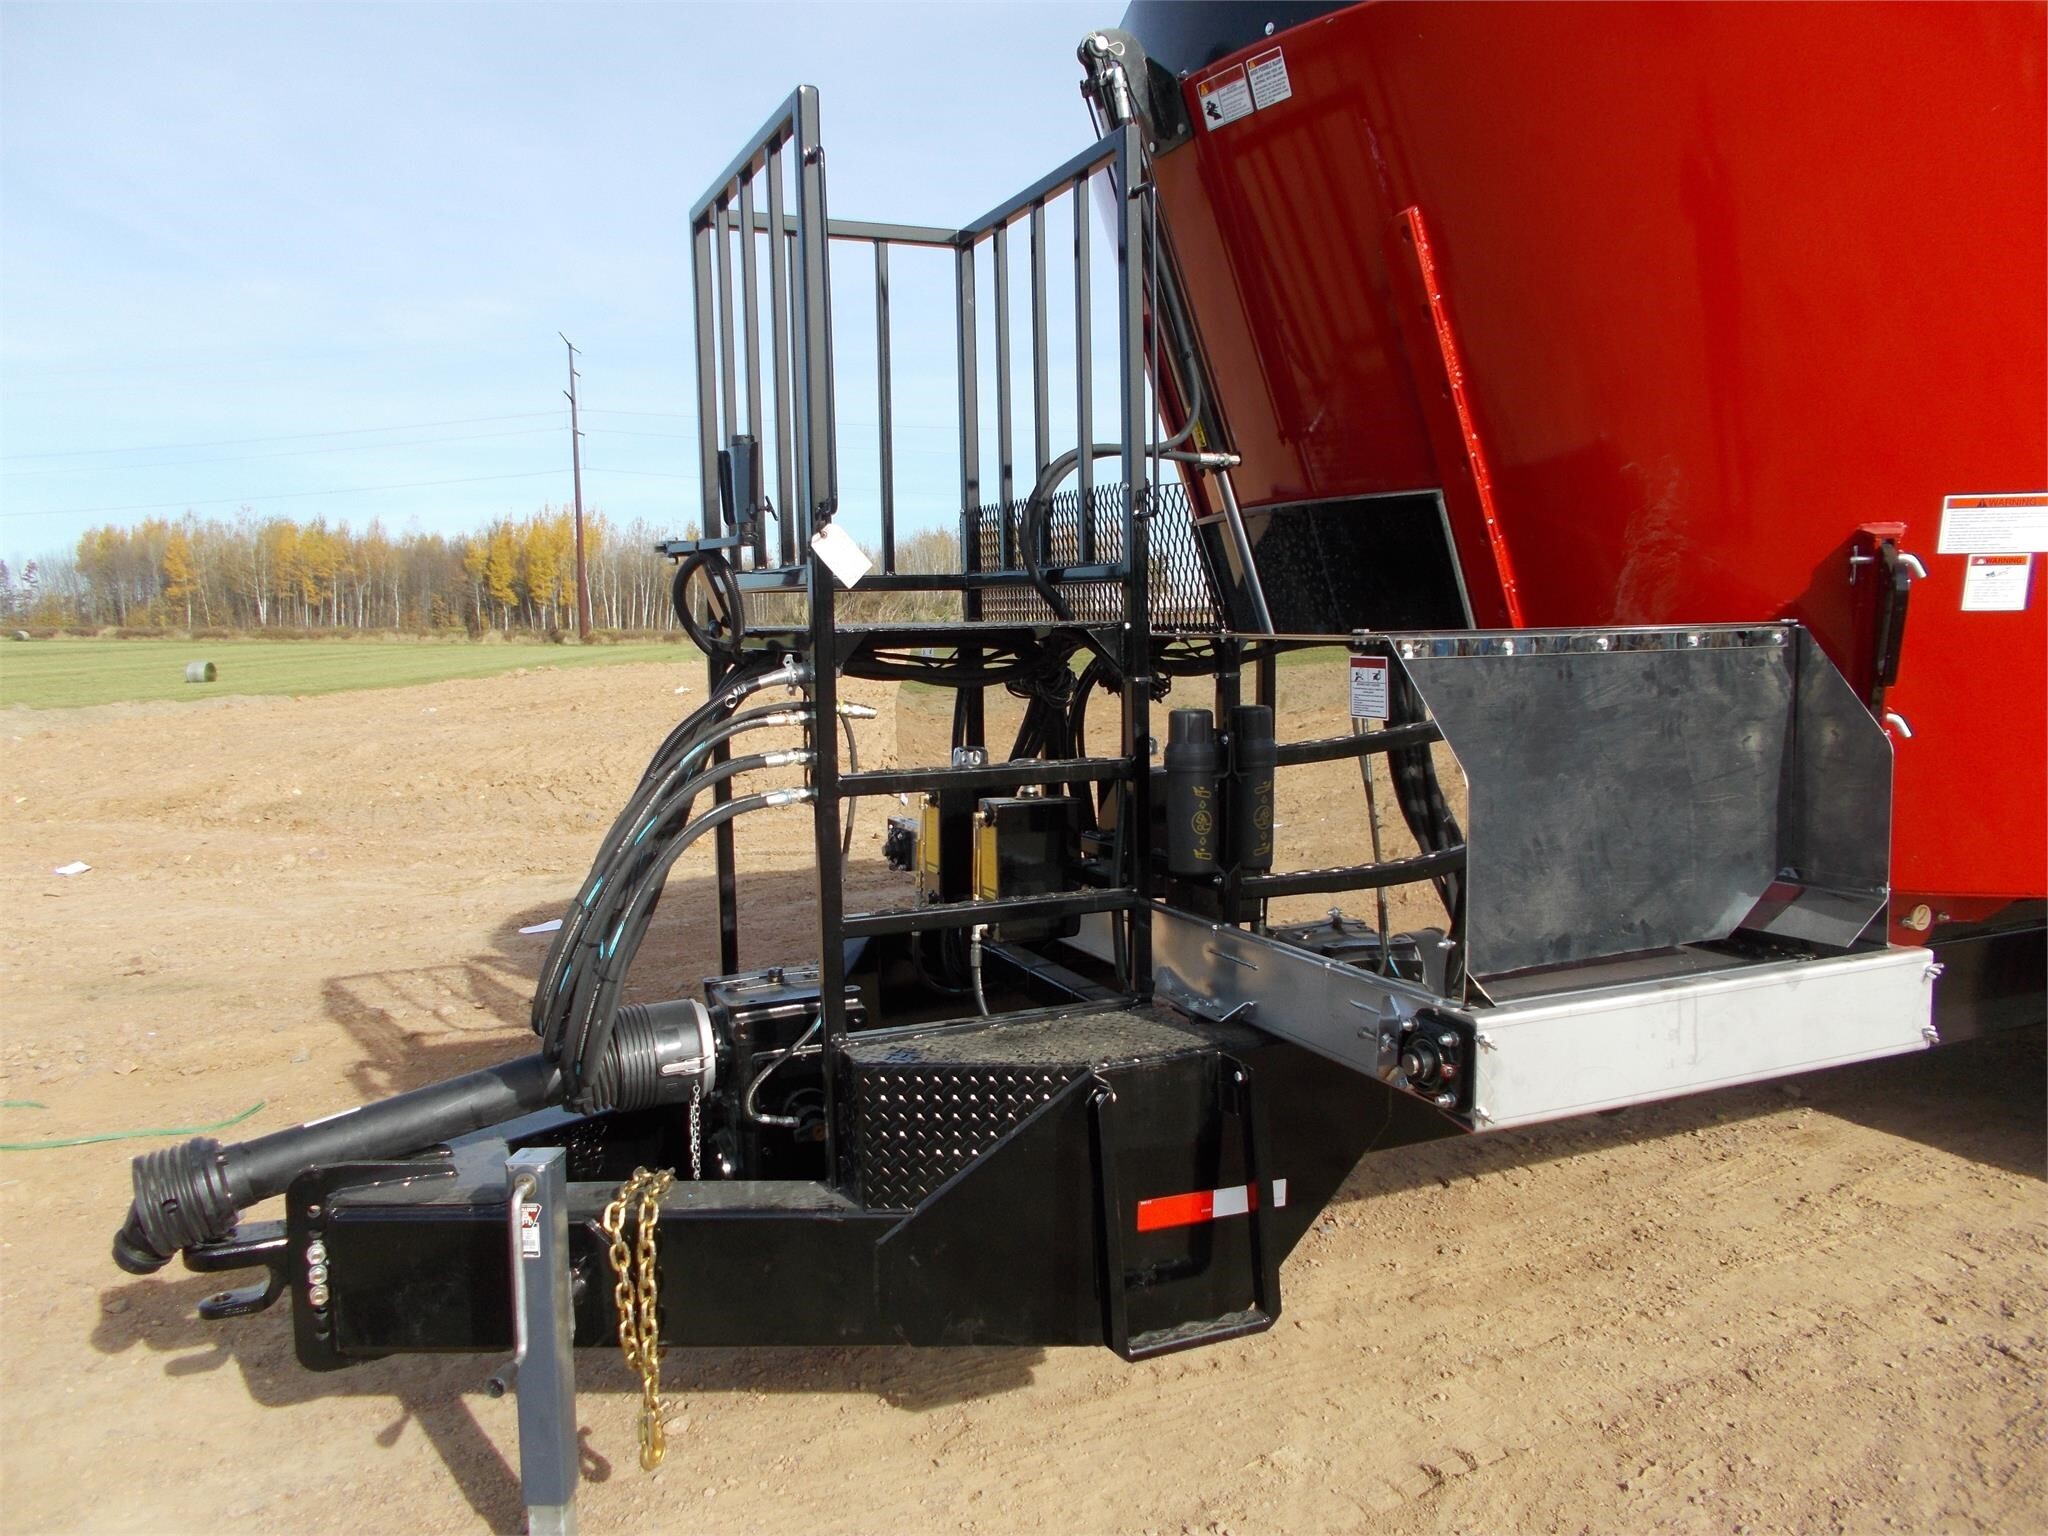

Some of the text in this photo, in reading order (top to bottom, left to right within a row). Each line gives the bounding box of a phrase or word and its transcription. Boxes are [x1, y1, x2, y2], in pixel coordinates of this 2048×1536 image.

[1988, 497, 2037, 507] WARNING
[1985, 557, 2022, 565] WARNING
[1916, 906, 1928, 925] 2
